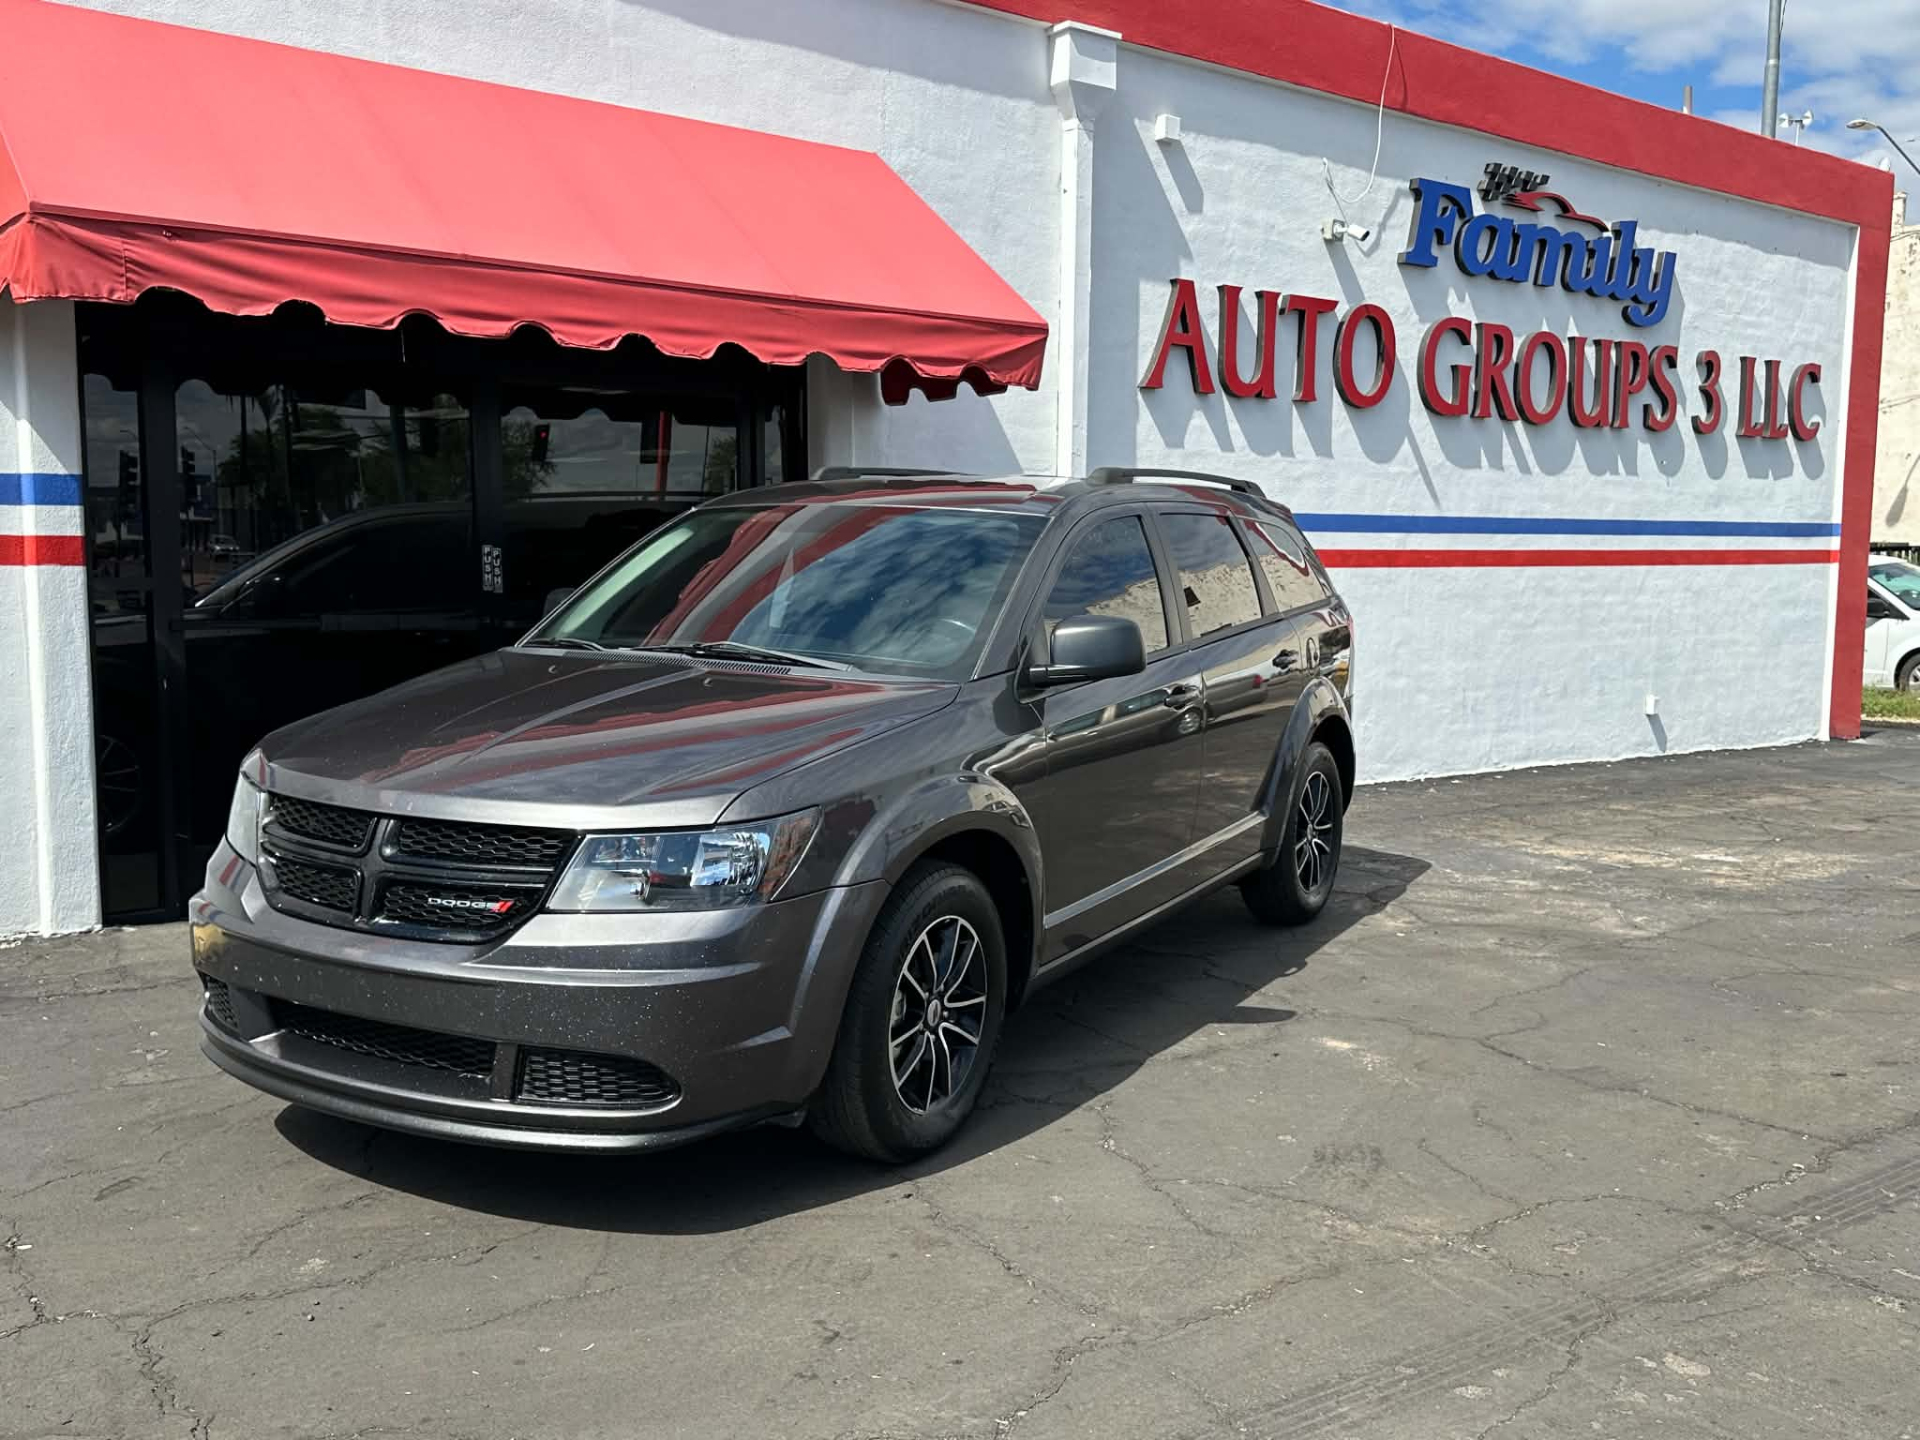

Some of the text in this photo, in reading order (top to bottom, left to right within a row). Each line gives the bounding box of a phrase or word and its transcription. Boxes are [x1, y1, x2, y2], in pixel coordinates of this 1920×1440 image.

[1397, 177, 1677, 328] Family
[1139, 278, 1822, 441] AUTO GROUPS 3 LLC
[484, 547, 492, 585] PUSH
[493, 550, 501, 585] PUSH
[428, 897, 498, 911] DODGE
